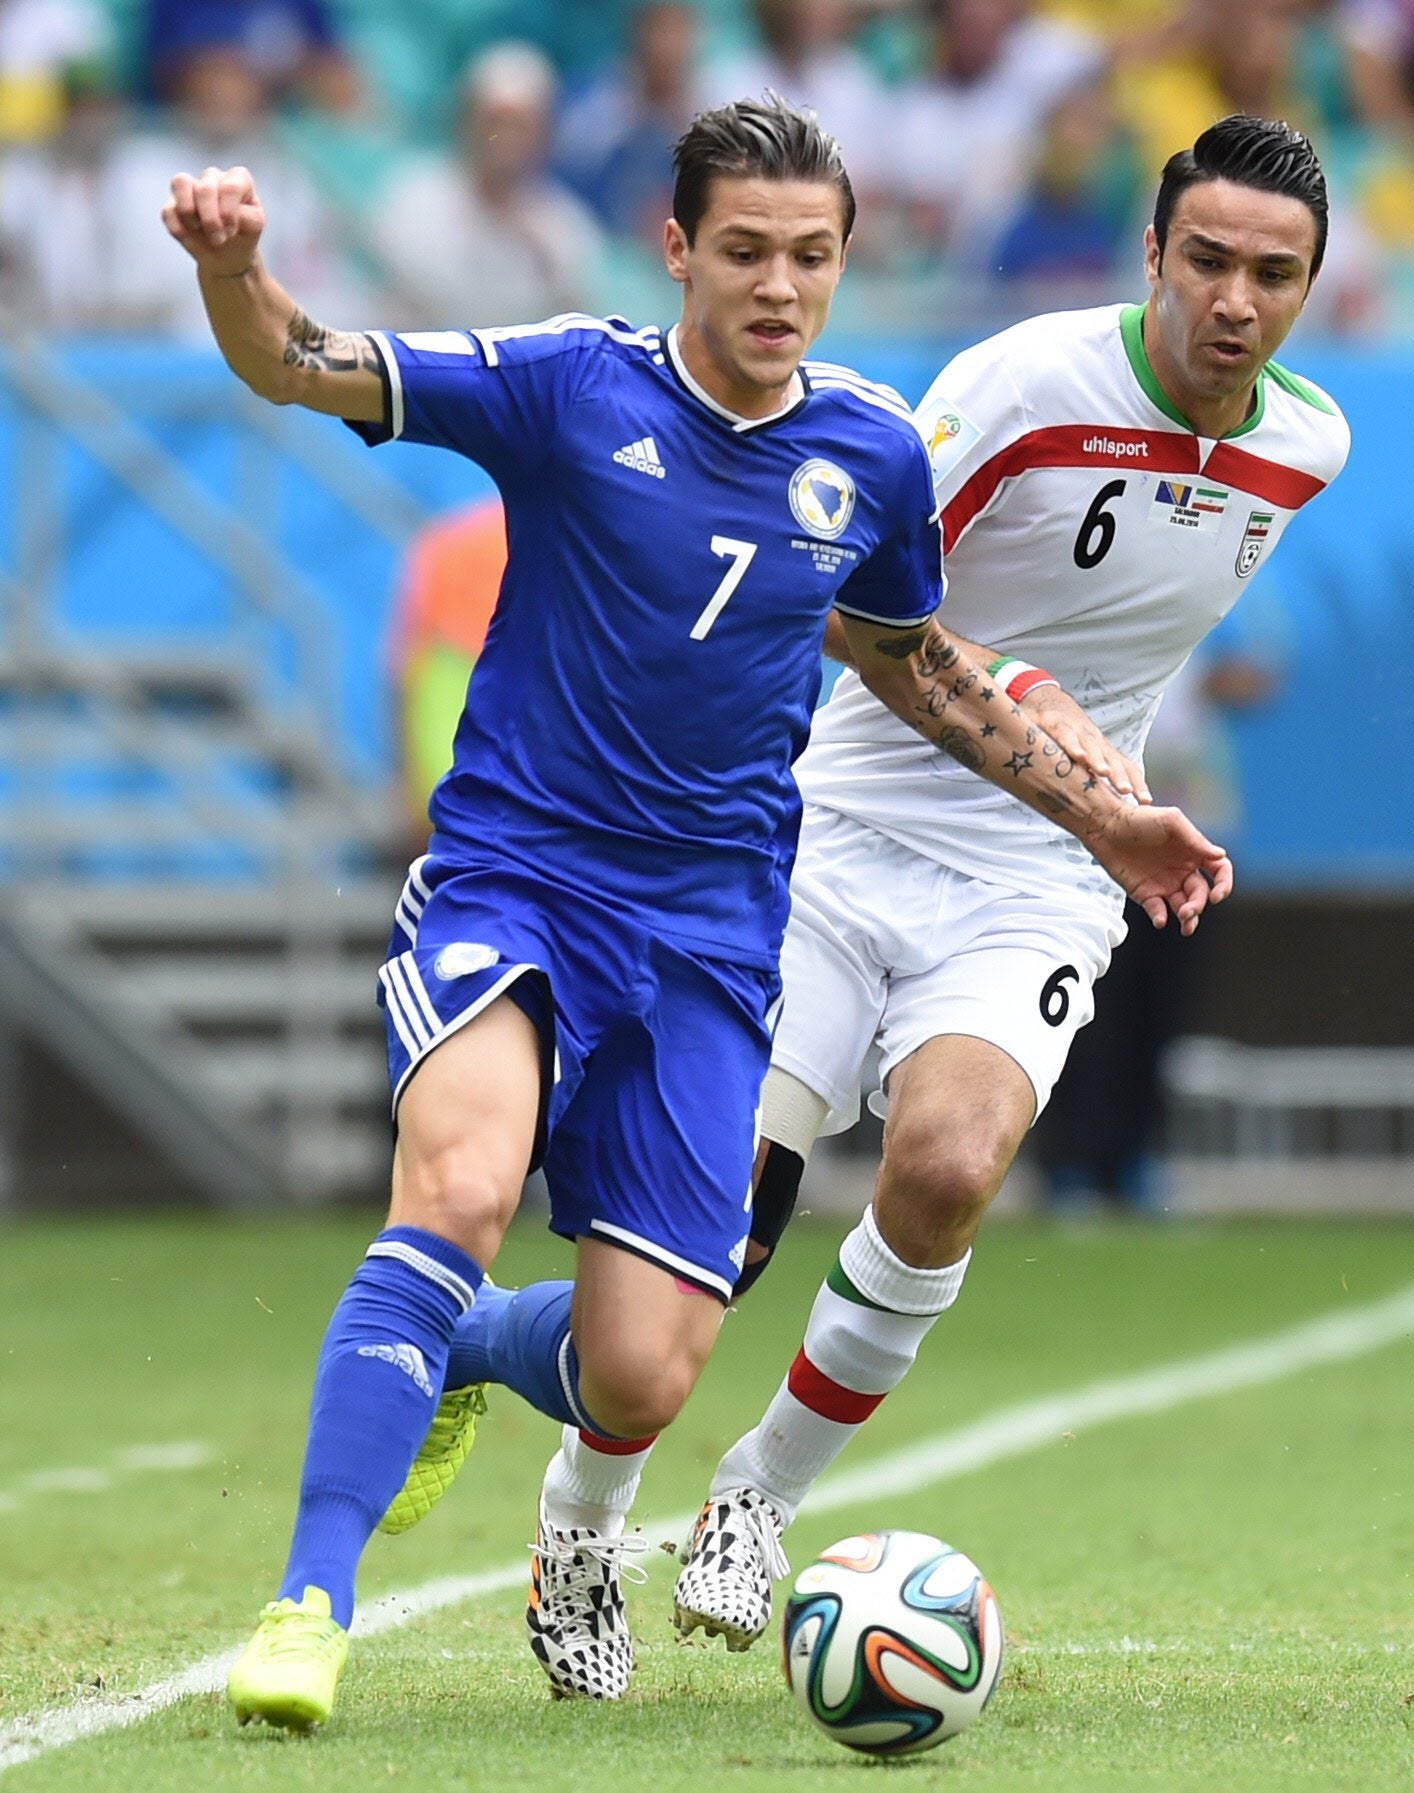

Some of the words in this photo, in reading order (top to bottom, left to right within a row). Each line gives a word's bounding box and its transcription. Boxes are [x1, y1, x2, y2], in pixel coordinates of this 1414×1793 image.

[612, 450, 666, 479] adidas
[1082, 435, 1149, 459] uhlsport
[1073, 479, 1127, 569] 6
[689, 535, 757, 641] 7
[1039, 964, 1080, 1027] 6
[357, 1345, 433, 1398] adidas
